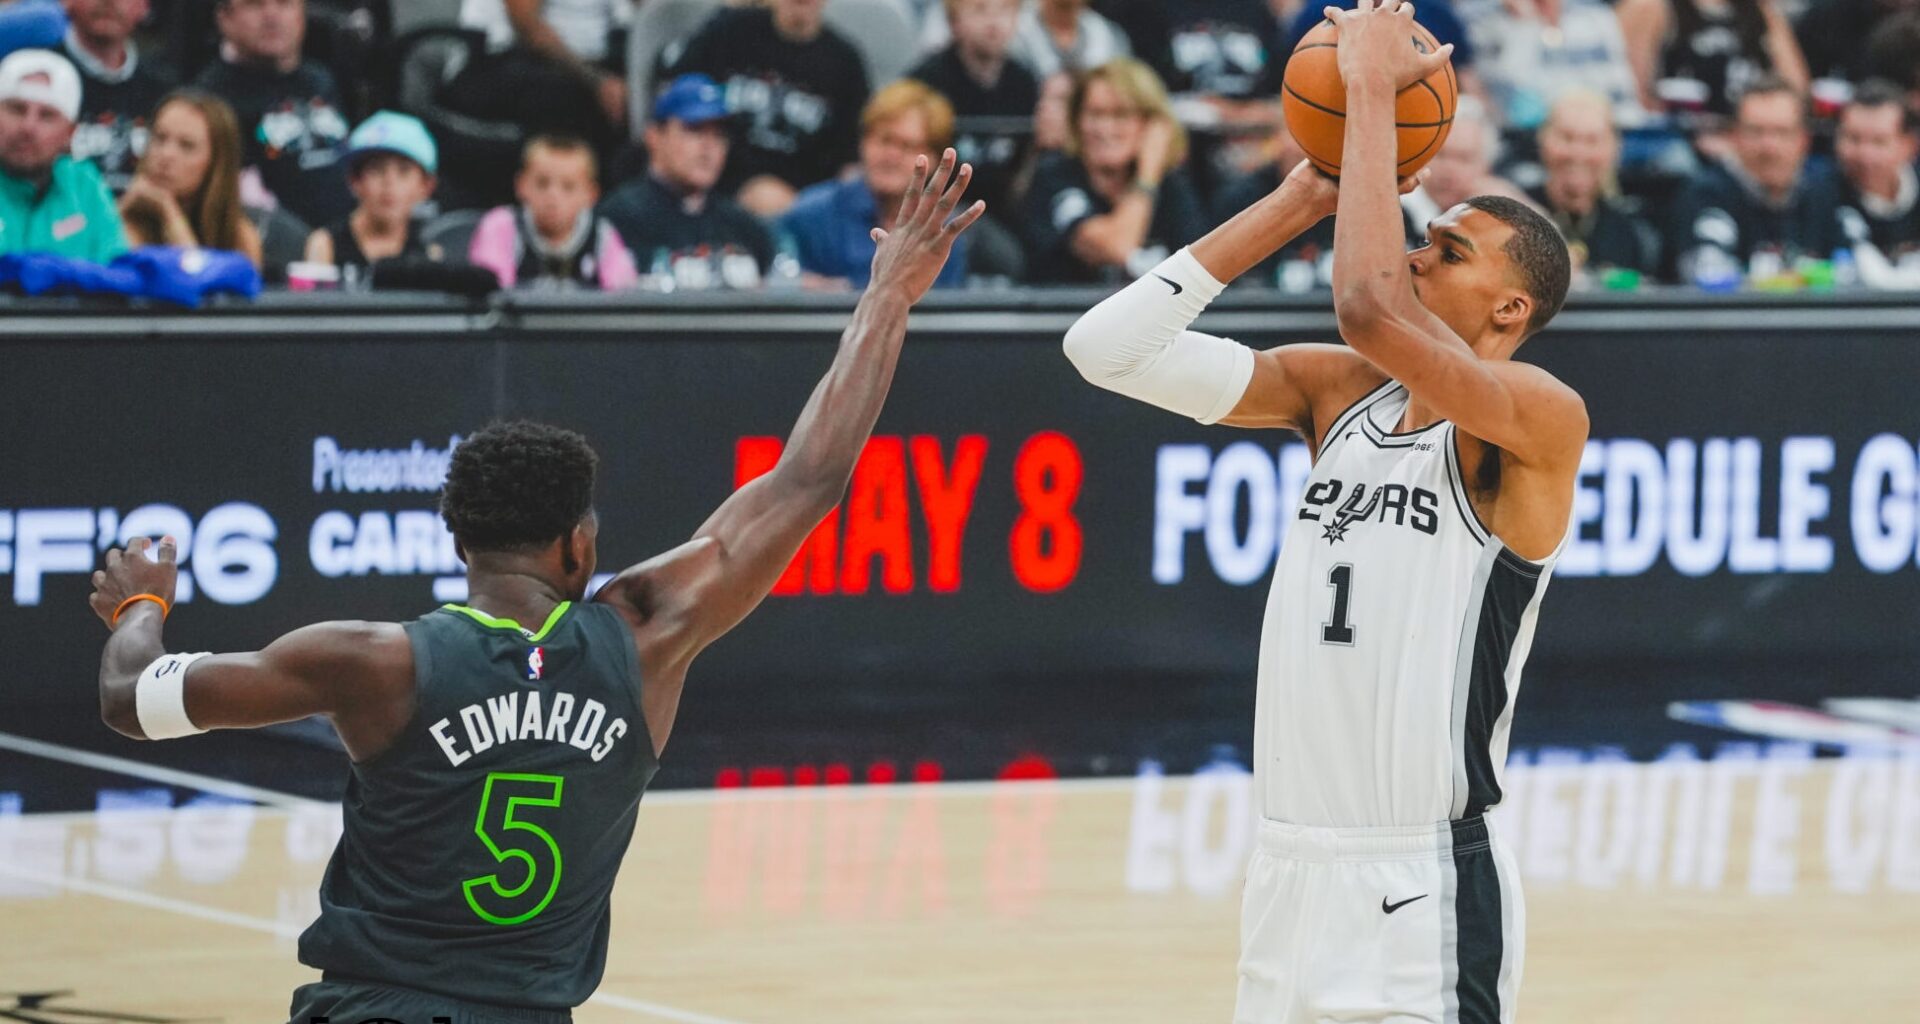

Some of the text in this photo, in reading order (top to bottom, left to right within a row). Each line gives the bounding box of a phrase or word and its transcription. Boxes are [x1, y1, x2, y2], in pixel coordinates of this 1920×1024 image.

[0, 501, 279, 605] F'26
[309, 510, 467, 578] CAR
[1008, 430, 1084, 593] 8
[1151, 432, 1920, 586] FO EDULE G
[1320, 561, 1356, 647] 1
[429, 691, 628, 767] EDWARDS
[462, 772, 564, 926] 5
